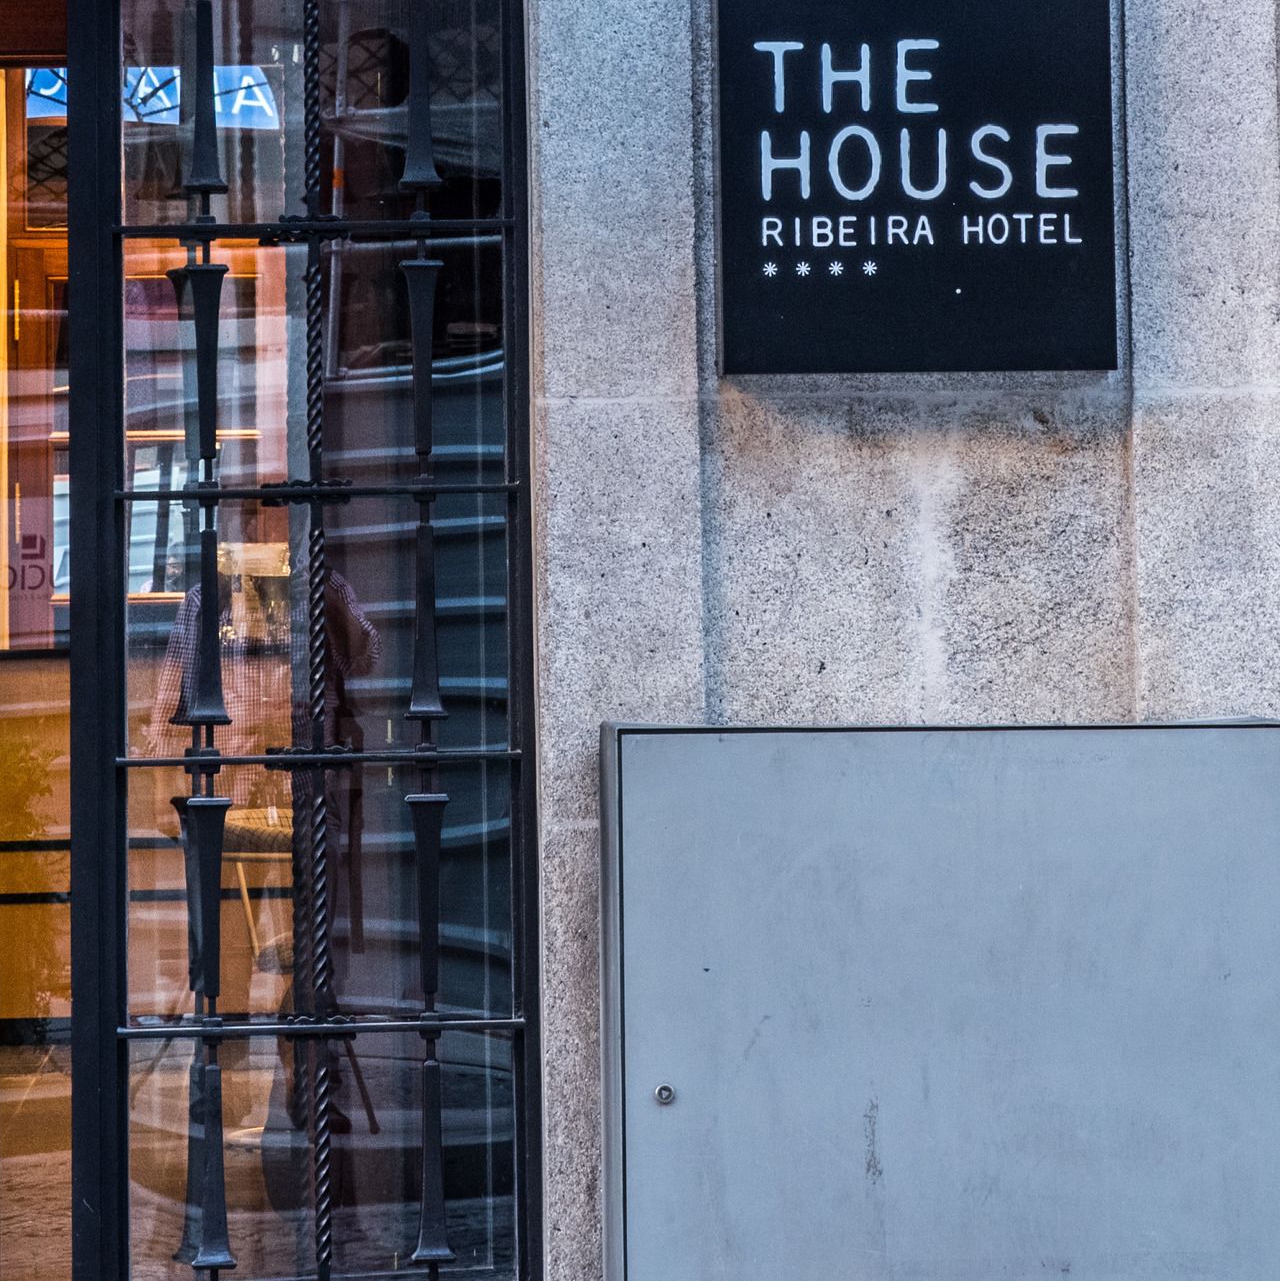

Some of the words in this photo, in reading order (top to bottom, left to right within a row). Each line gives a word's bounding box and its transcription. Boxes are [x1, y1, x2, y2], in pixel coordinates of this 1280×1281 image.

[753, 38, 940, 114] THE
[760, 124, 1080, 202] HOUSE
[761, 215, 935, 248] RIBEIRA
[963, 214, 1083, 245] HOTEL
